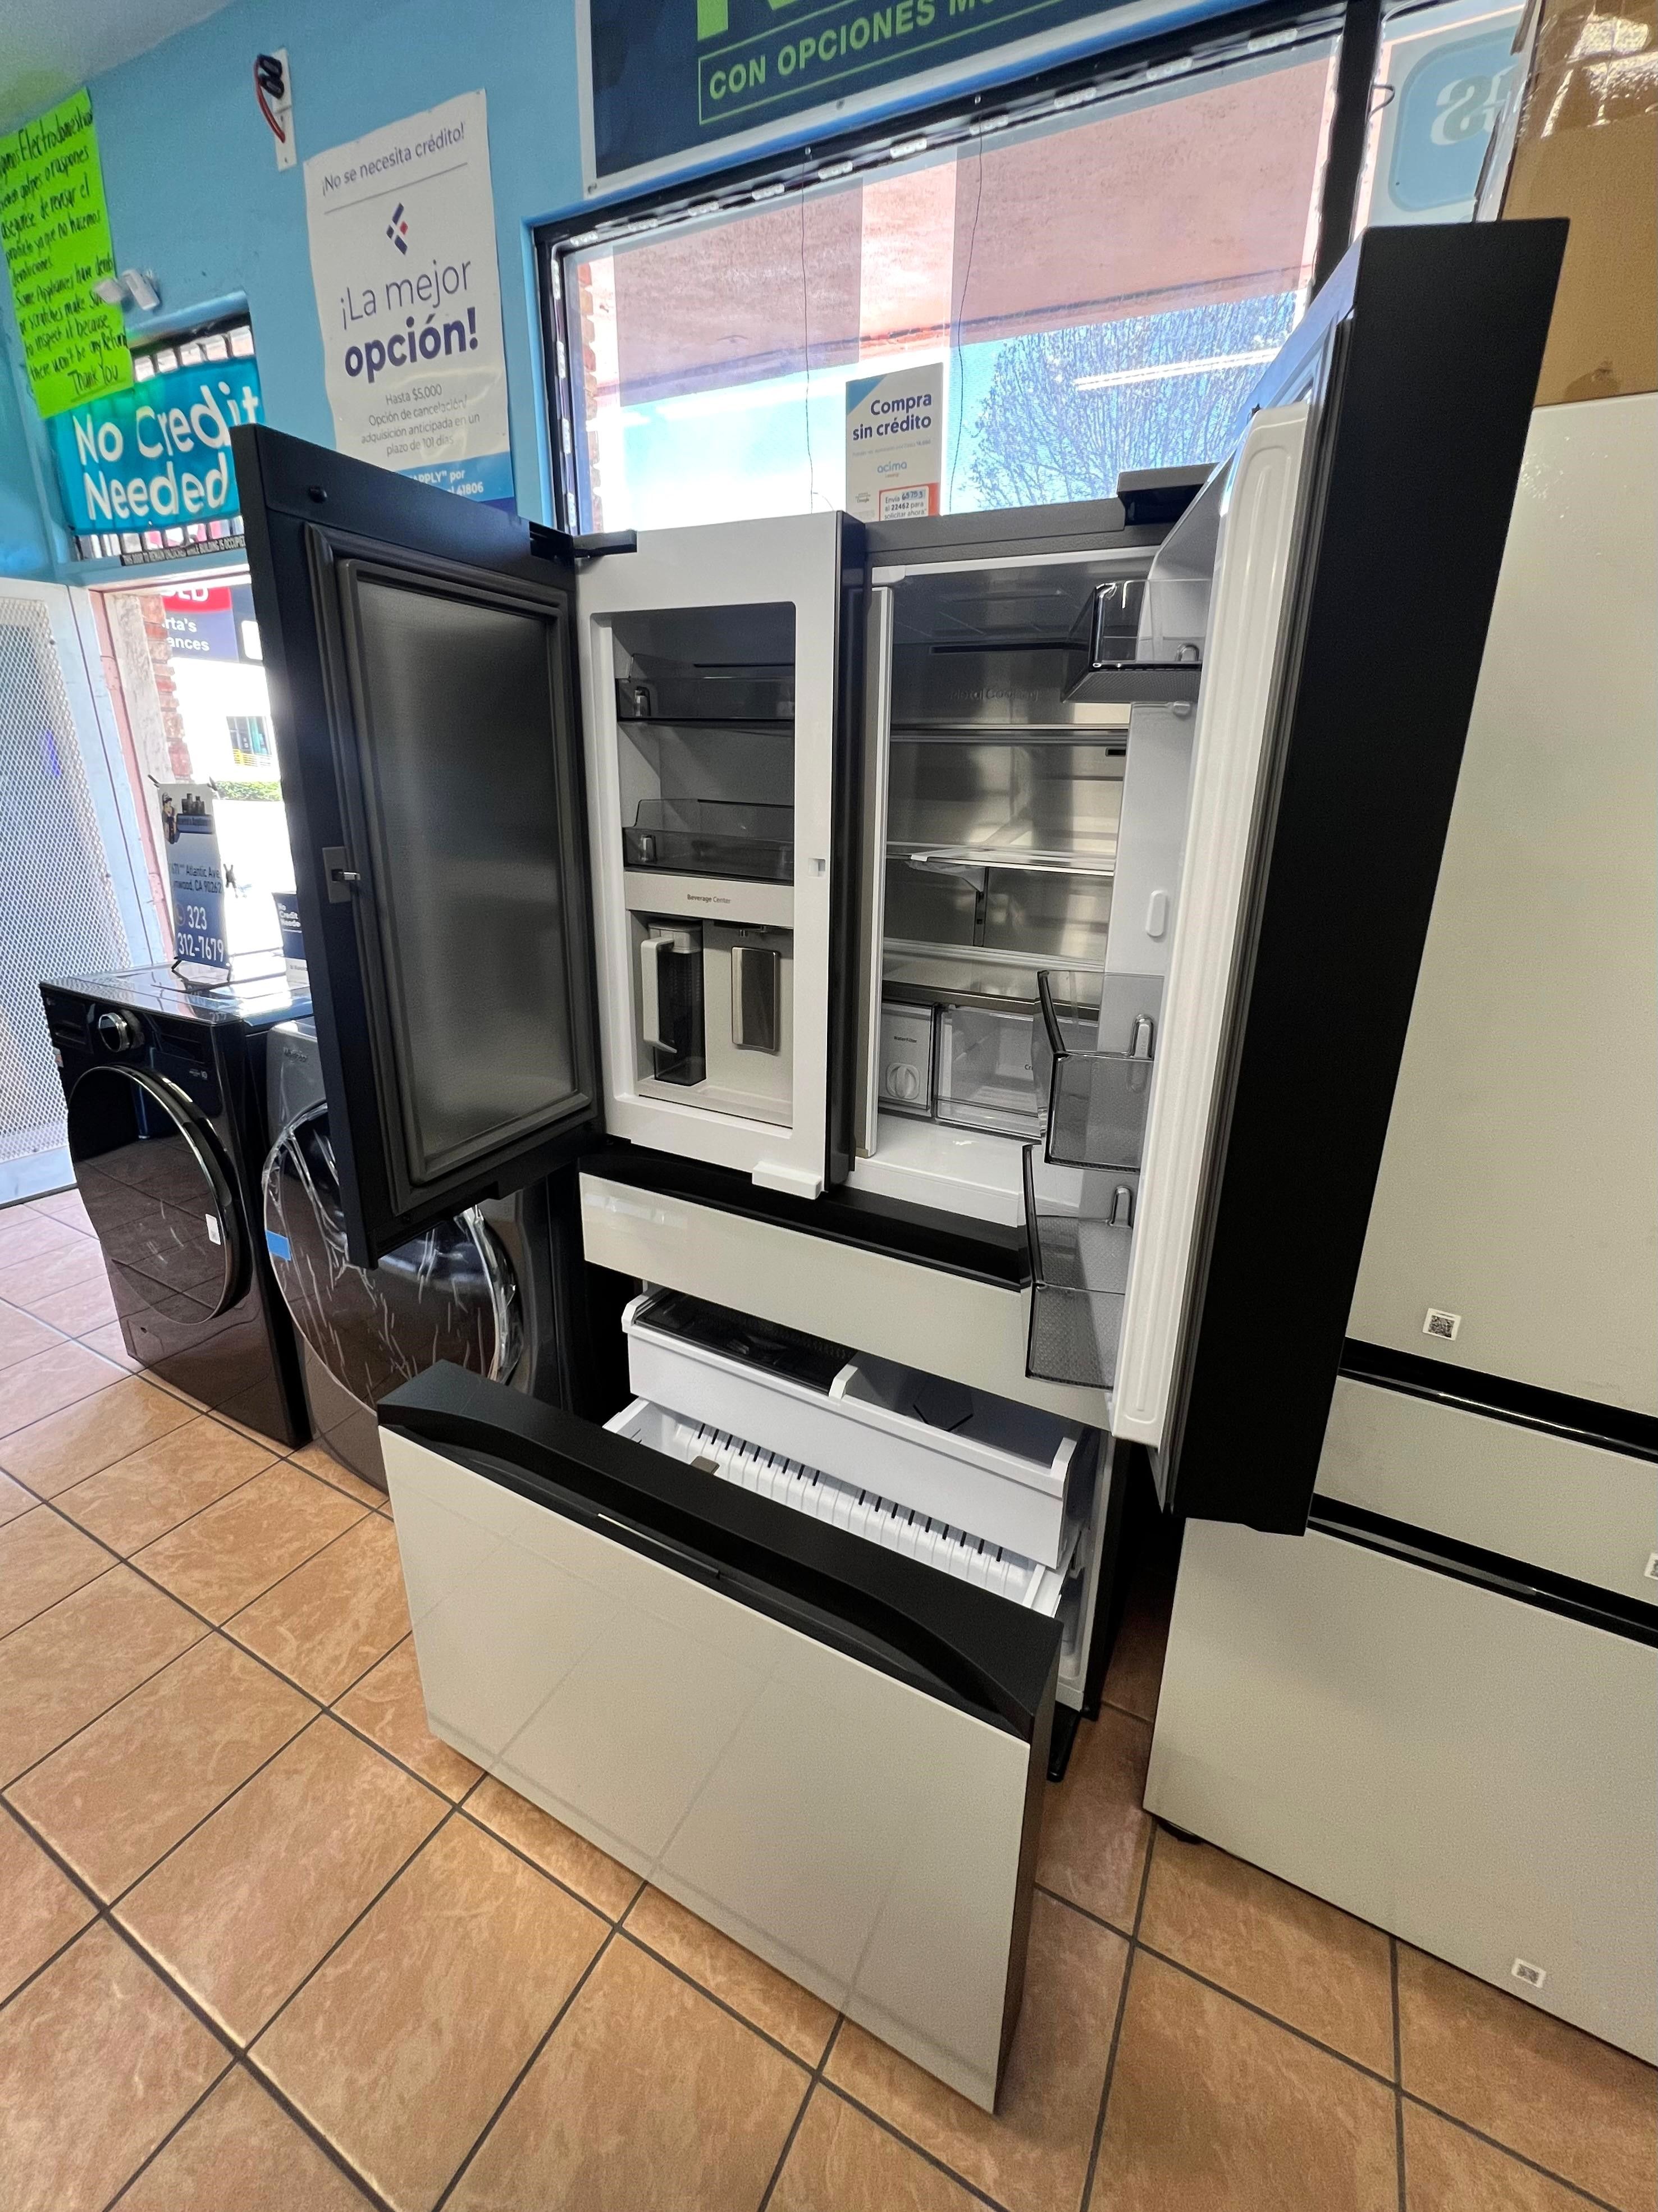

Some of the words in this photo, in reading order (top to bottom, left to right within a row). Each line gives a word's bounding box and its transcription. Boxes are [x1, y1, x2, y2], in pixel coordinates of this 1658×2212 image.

[709, 55, 766, 100] CON
[778, 0, 935, 76] OPCIONES
[322, 175, 341, 196] ¡No
[344, 170, 357, 184] se
[360, 147, 412, 179] necesita
[415, 121, 465, 157] crédito!
[340, 286, 376, 330] ¡La
[386, 259, 471, 309] mejor
[345, 307, 478, 383] opción!
[67, 366, 99, 396] Thank
[386, 391, 411, 405] Hasta
[412, 383, 442, 401] $5,000
[871, 394, 932, 415] Compra
[72, 413, 123, 465] No
[136, 381, 258, 459] Credit
[368, 409, 399, 427] Opción
[400, 408, 412, 421] de
[408, 415, 454, 436] anticipada
[455, 415, 467, 427] en
[468, 413, 481, 424] un
[853, 423, 873, 441] sin
[876, 414, 931, 436] crédito
[386, 442, 409, 459] plazo
[410, 438, 421, 451] de
[422, 436, 435, 449] 101
[450, 469, 465, 483] por
[877, 460, 907, 473] acima
[84, 452, 229, 520] Needed
[457, 481, 483, 495] 41806
[884, 511, 906, 520] solicitar
[161, 617, 197, 633] rta's
[194, 879, 203, 892] CA
[687, 894, 712, 903] Beverage
[712, 896, 732, 904] Center
[187, 905, 207, 930] 323
[177, 932, 224, 962] 312-7679
